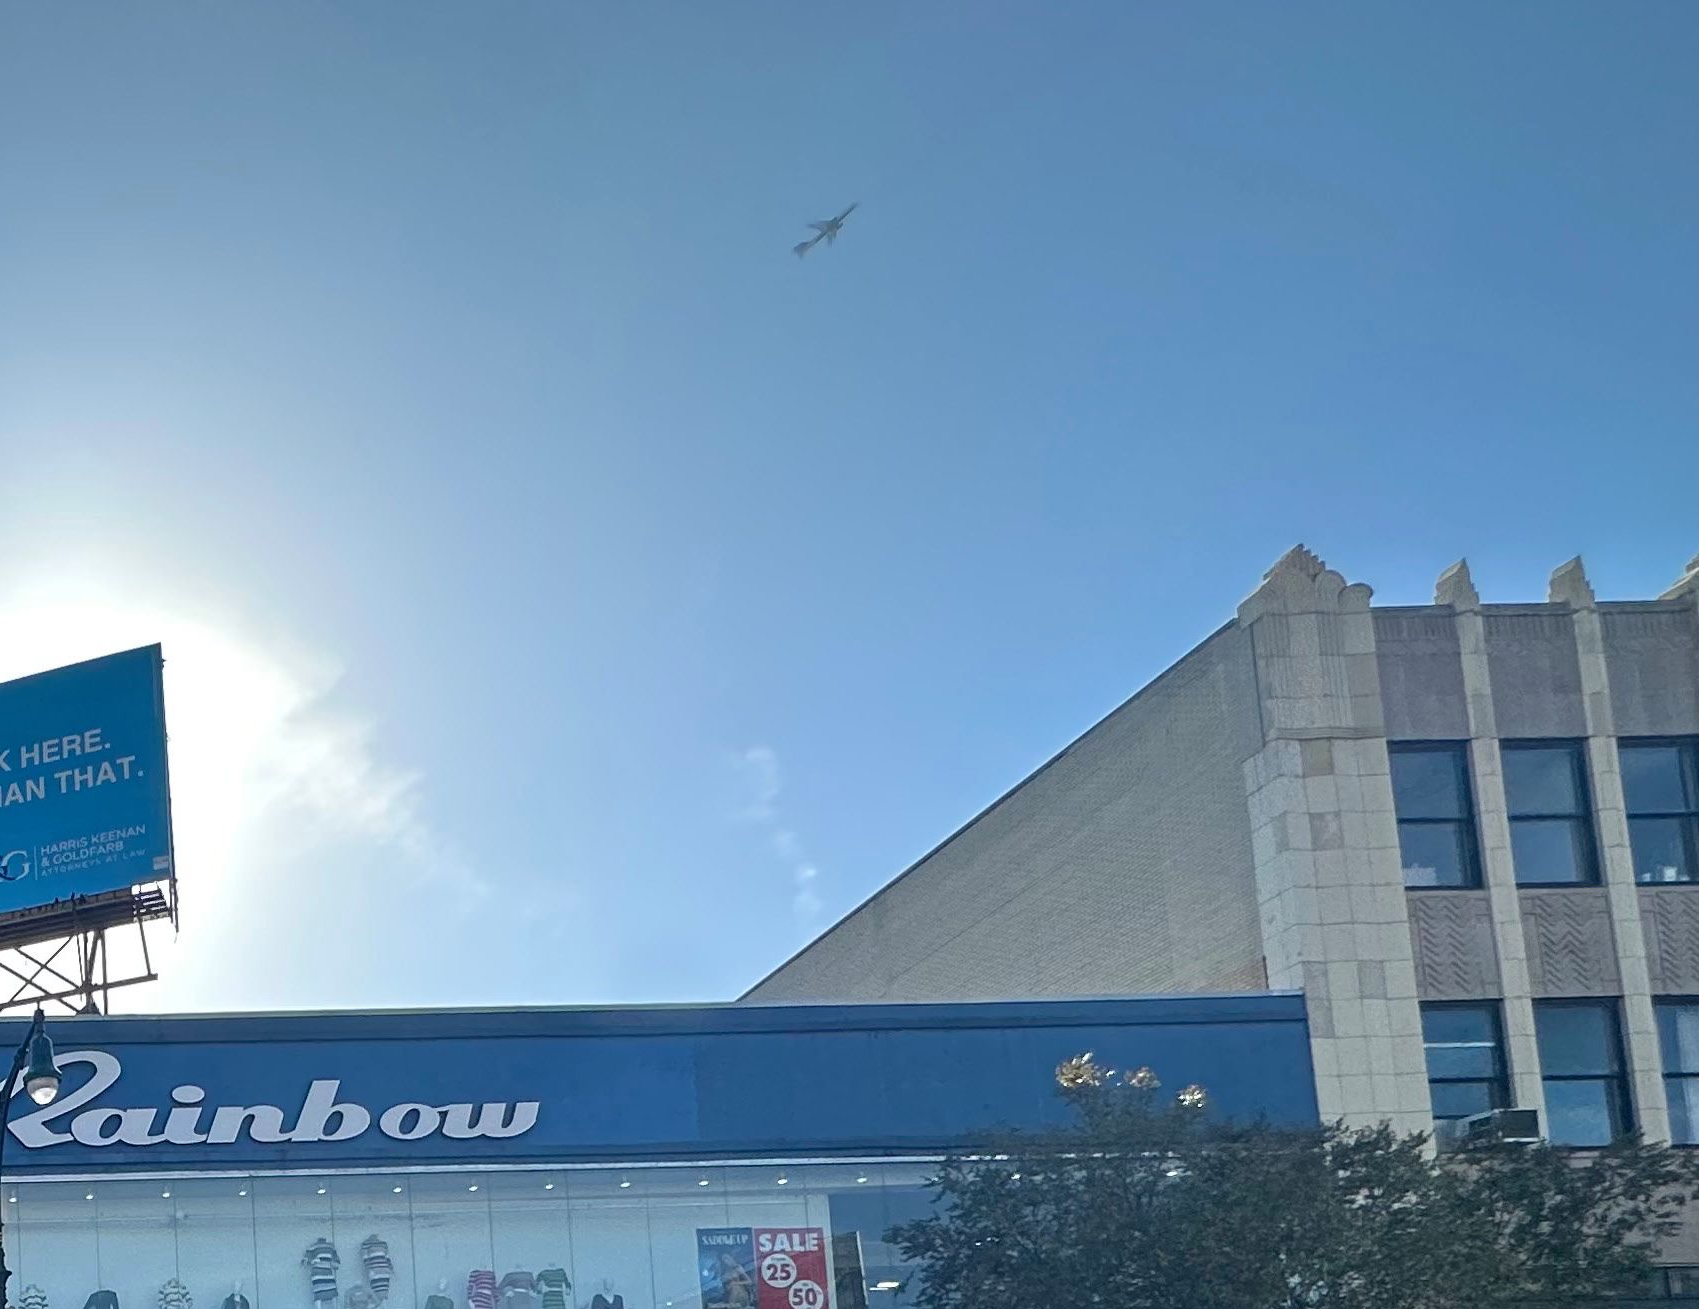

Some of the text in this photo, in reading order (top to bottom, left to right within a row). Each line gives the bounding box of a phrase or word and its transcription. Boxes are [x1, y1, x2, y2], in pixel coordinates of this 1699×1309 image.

[20, 728, 111, 767] HERE.
[53, 755, 144, 794] THAT.
[41, 824, 146, 856] HARRIS KEENAN
[41, 841, 124, 867] & GOLDFARB
[122, 849, 146, 861] LAW
[759, 1233, 819, 1252] SALE
